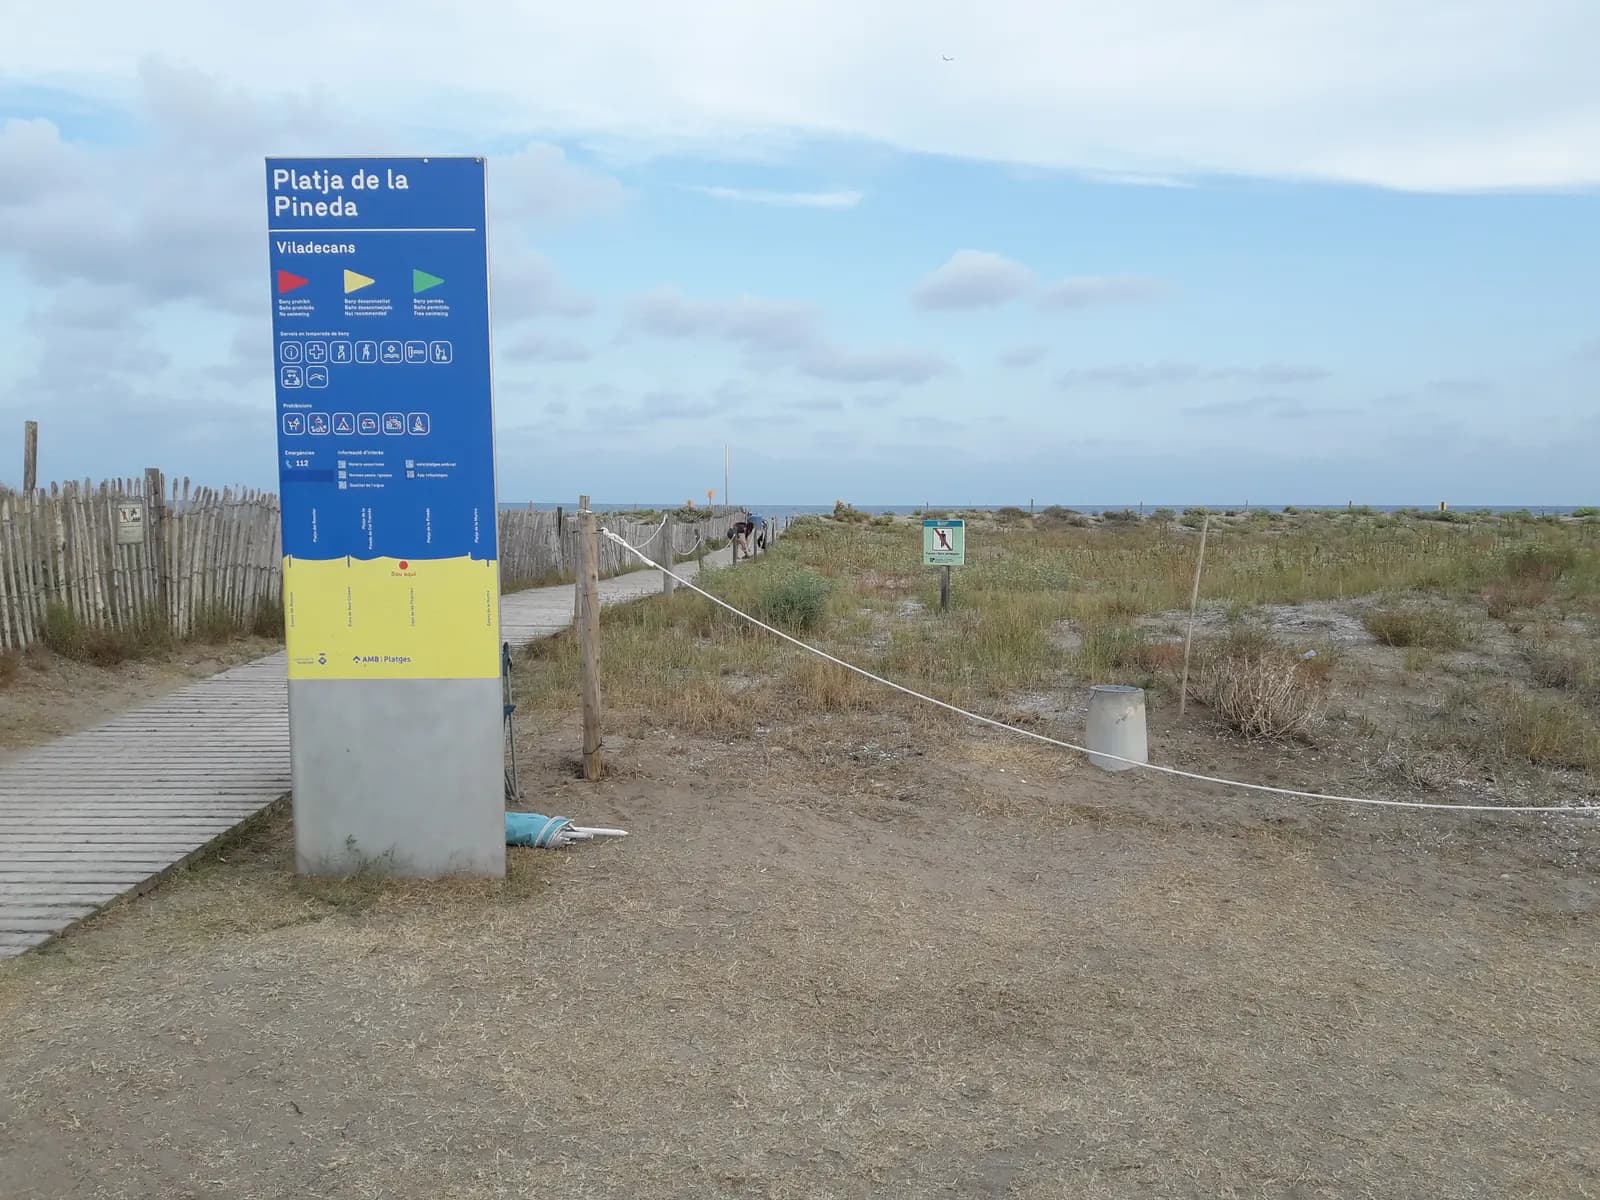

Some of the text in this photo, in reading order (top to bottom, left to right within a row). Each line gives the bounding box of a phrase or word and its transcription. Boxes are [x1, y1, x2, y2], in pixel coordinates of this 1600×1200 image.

[273, 168, 409, 194] Platja de la
[274, 196, 358, 217] Pineda
[277, 241, 356, 254] Viladecans
[384, 656, 411, 665] Platges
